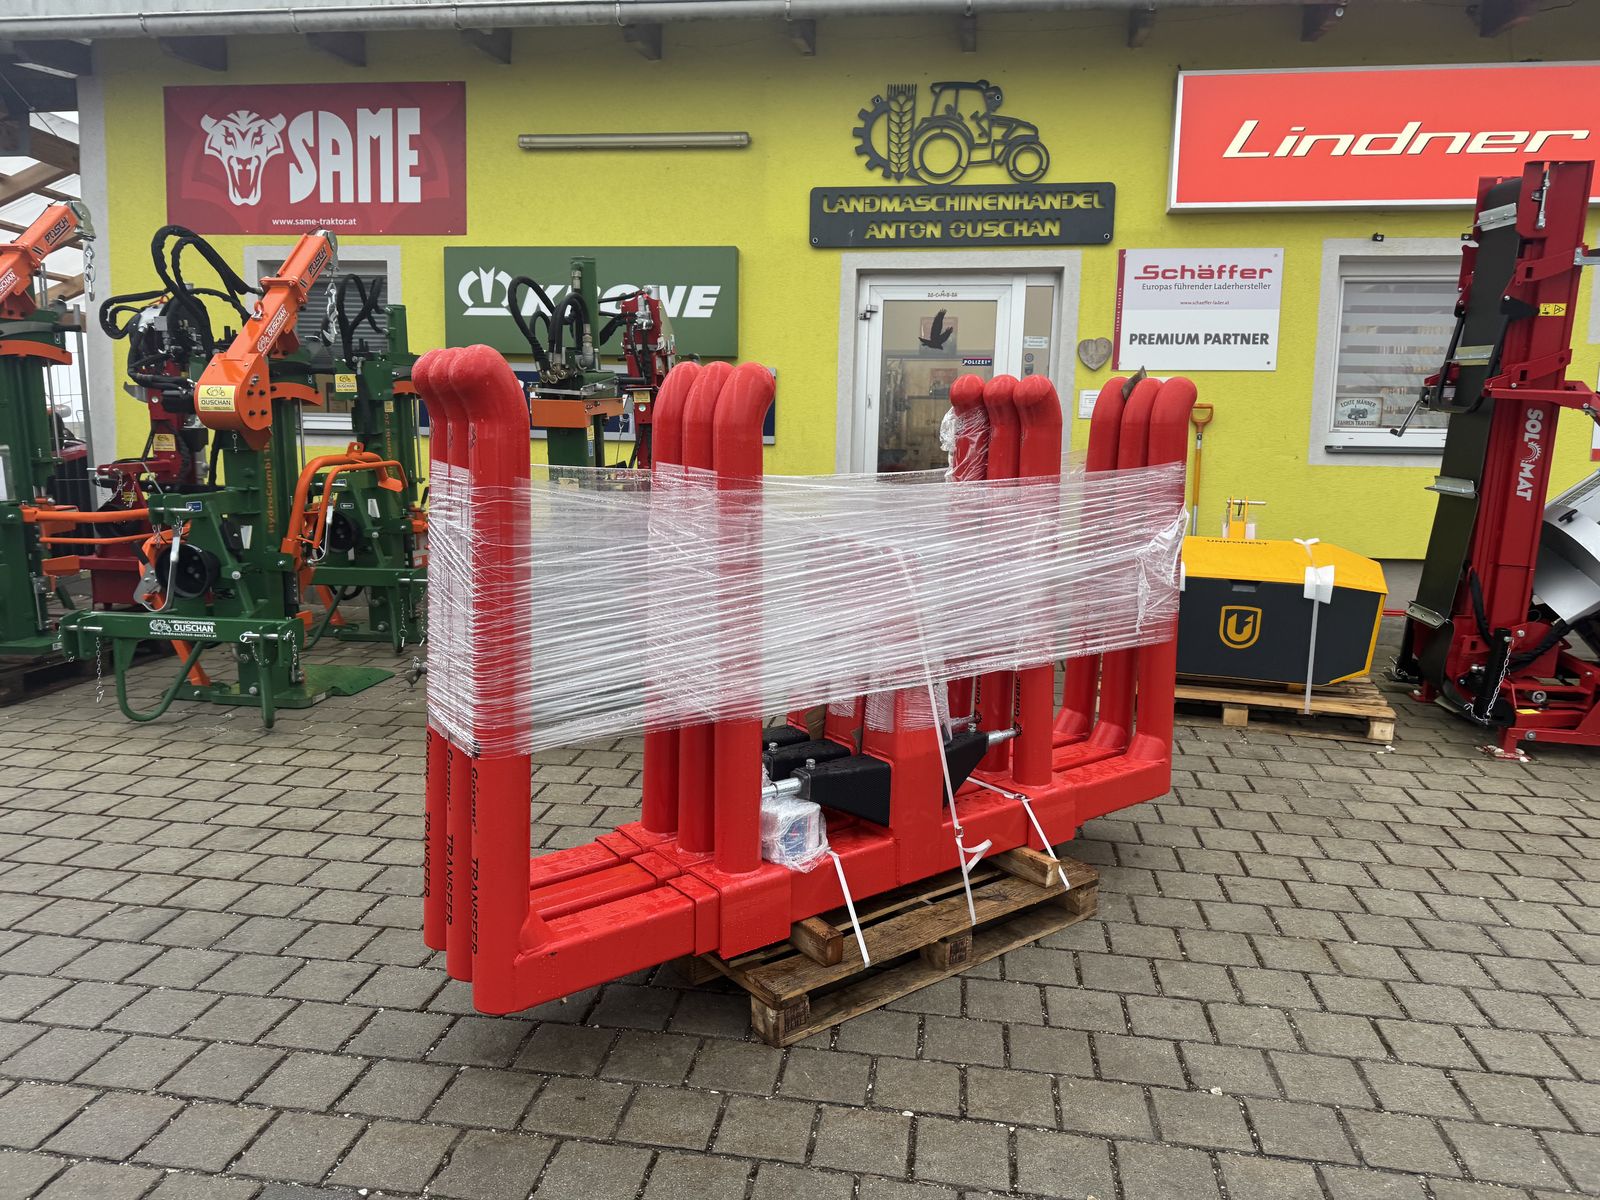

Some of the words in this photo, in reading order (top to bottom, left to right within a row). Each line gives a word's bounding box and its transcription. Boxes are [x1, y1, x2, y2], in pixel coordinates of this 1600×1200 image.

[1222, 120, 1590, 158] Lindner
[288, 108, 421, 203] SAME
[823, 191, 1105, 213] LANDMASCHINENHANDEL
[272, 217, 357, 226] www.same-traktor.at
[864, 220, 942, 239] ANTON
[949, 219, 1061, 238] OUSCHAN
[1134, 264, 1272, 280] Schäffer
[1142, 283, 1172, 291] Europas
[1174, 282, 1213, 291] führender
[1213, 282, 1271, 290] Laderhersteller
[1129, 333, 1199, 345] PREMIUM
[1204, 333, 1269, 345] PARTNER
[173, 623, 214, 633] OUSCHAN
